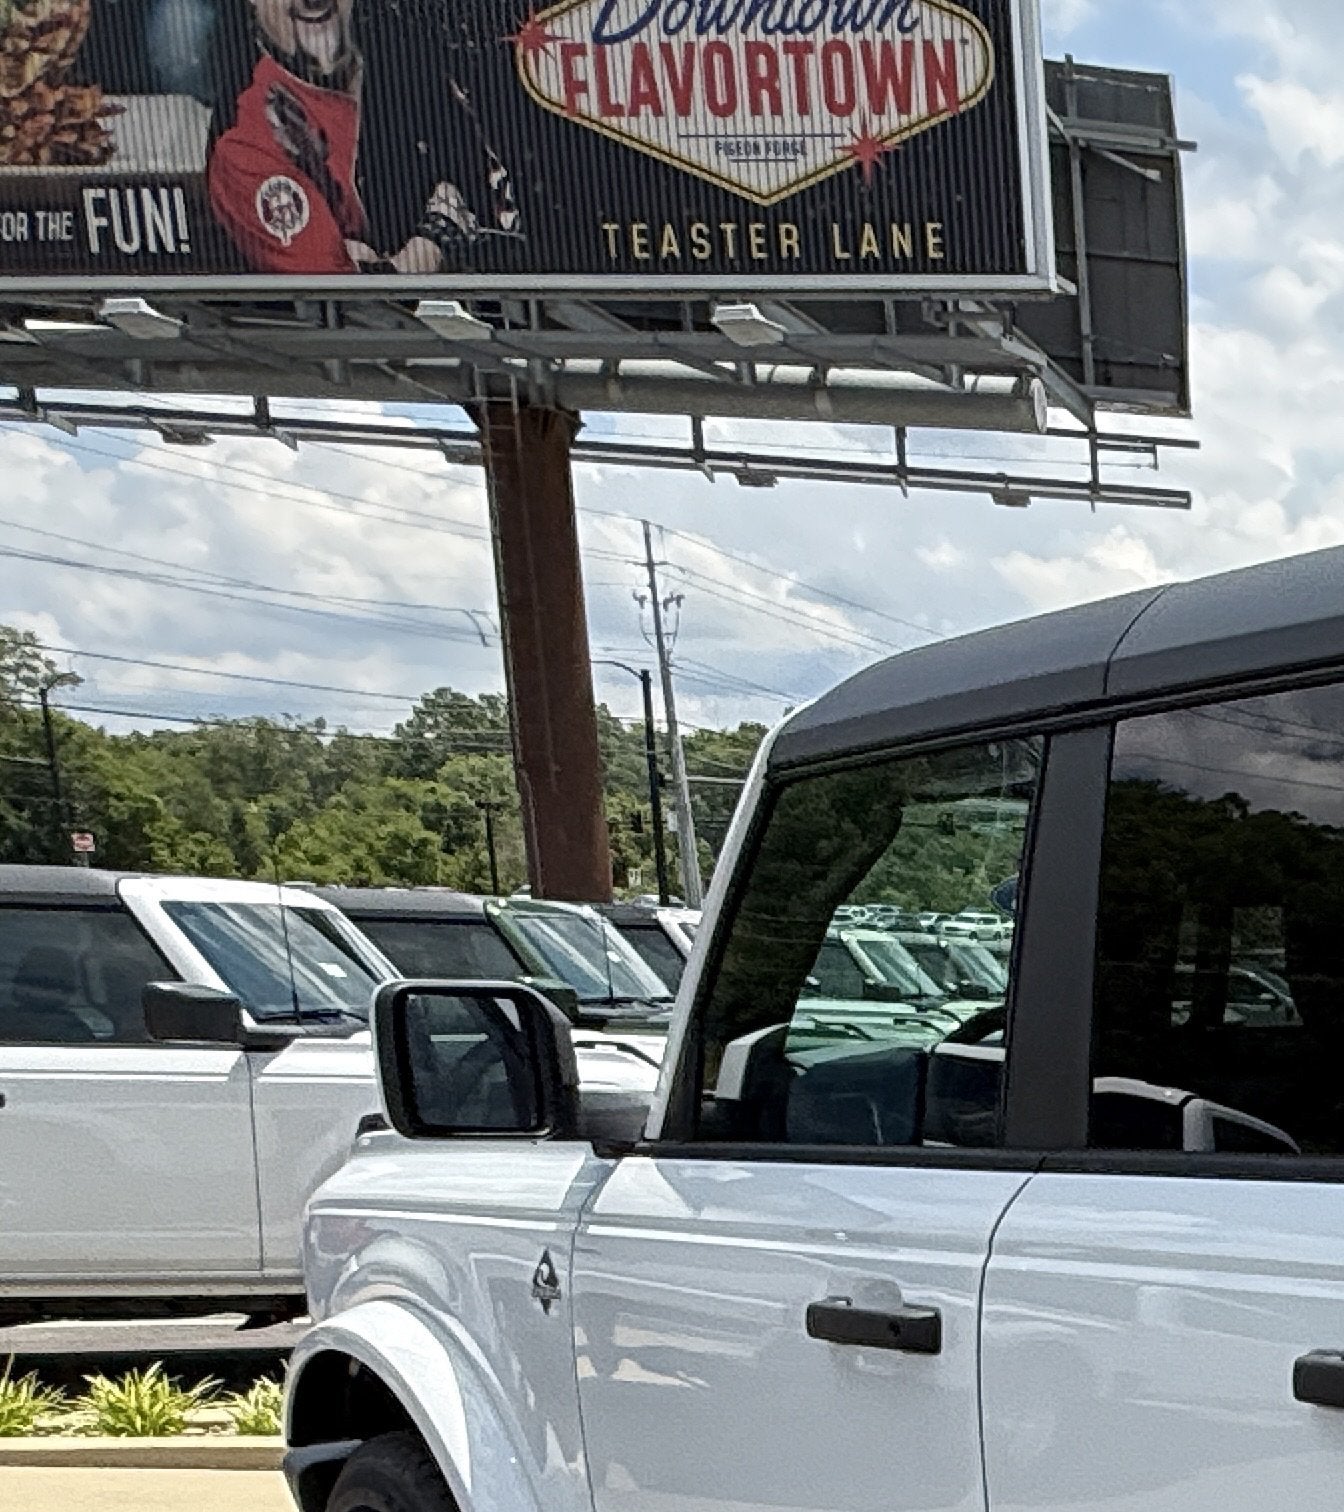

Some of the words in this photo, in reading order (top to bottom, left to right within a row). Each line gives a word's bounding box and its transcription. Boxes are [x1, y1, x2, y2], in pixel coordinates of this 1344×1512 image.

[560, 38, 960, 119] FLAVORTOWN
[715, 140, 761, 156] PIGEON
[764, 140, 807, 156] FORGE
[0, 212, 28, 242] OR
[35, 211, 73, 242] THE
[82, 187, 191, 254] FUN!
[602, 222, 801, 260] TEASTER
[833, 222, 945, 260] LANE
